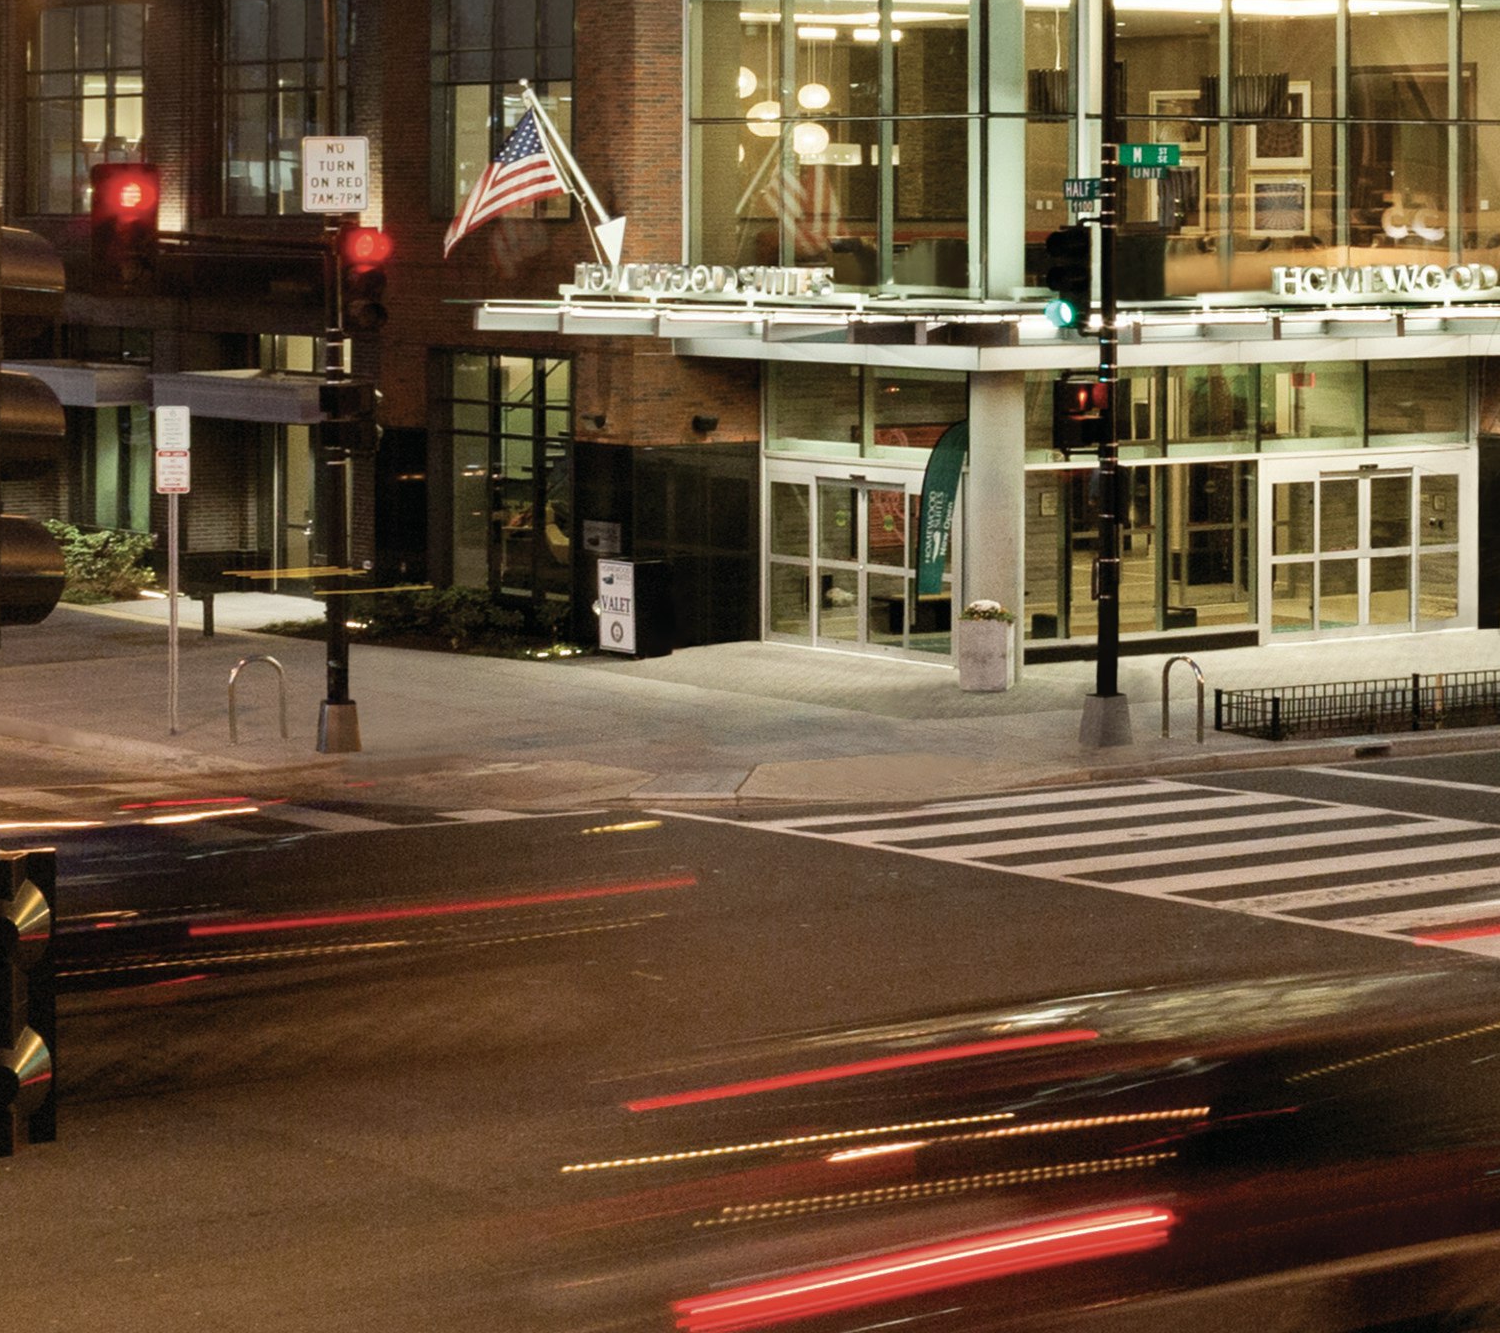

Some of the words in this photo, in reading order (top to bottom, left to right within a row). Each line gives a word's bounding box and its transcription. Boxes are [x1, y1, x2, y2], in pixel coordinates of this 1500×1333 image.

[1133, 147, 1142, 163] M
[319, 160, 355, 172] TURN
[1133, 168, 1161, 179] UNIT
[311, 177, 329, 188] ON
[337, 177, 363, 188] RED
[1065, 181, 1090, 197] HALF
[943, 501, 954, 530] Open
[940, 532, 949, 556] New
[601, 594, 631, 613] VALET
